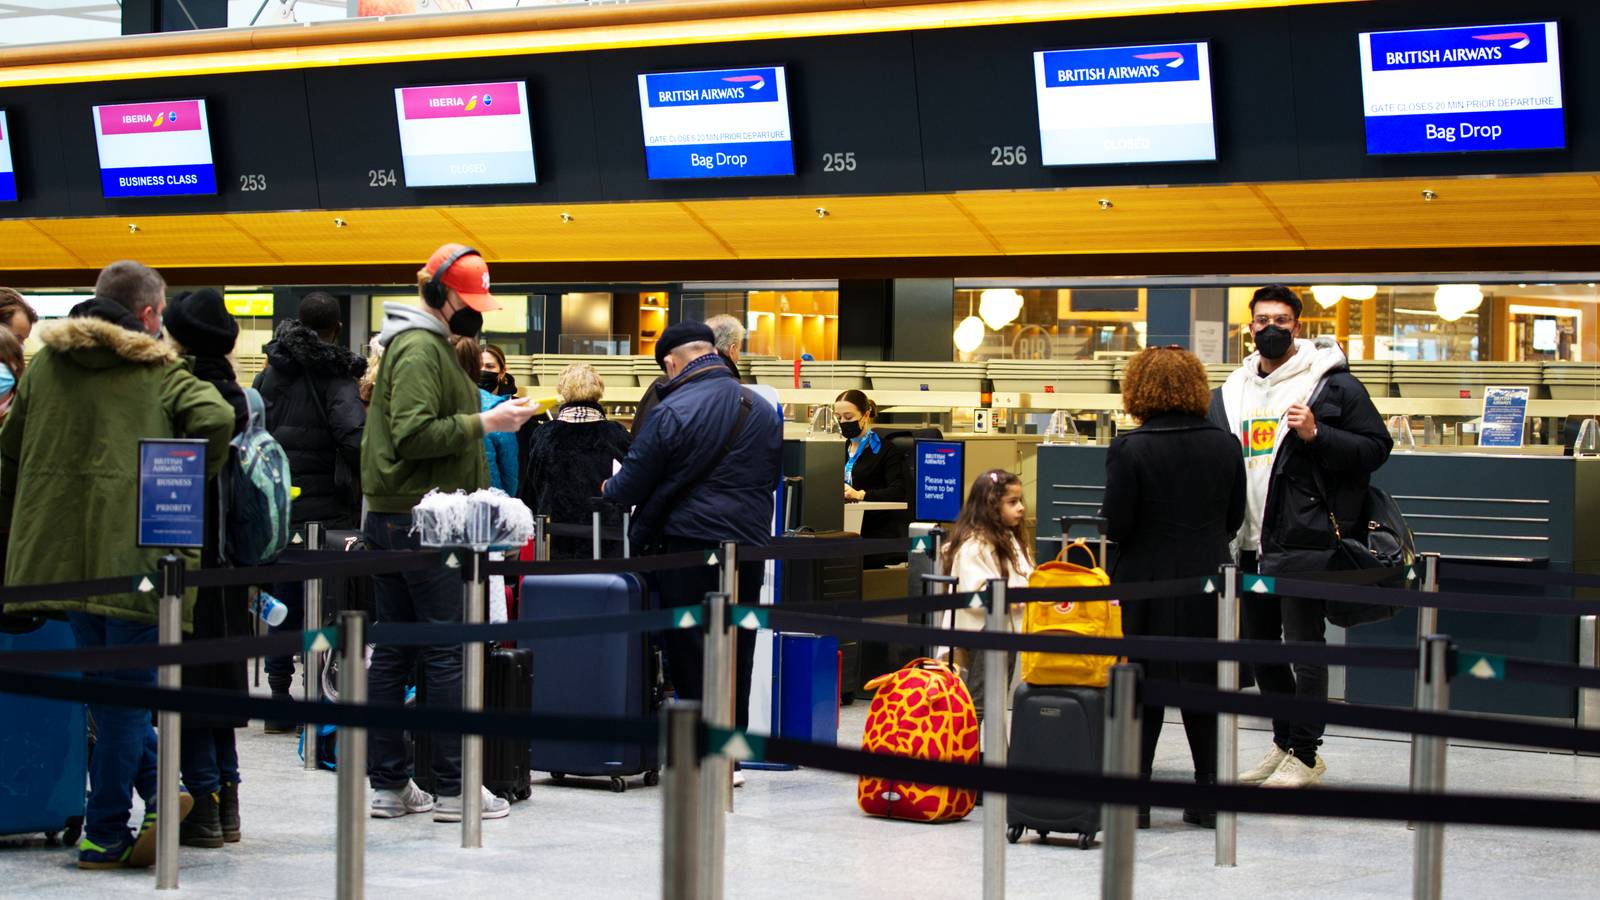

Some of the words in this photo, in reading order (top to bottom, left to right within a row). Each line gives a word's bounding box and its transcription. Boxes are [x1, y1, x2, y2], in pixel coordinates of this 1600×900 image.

[1386, 49, 1440, 65] BRITISH
[1442, 46, 1502, 62] AIRWAYS
[1057, 68, 1106, 82] BRITISH
[1107, 65, 1160, 80] AIRWAYS
[658, 89, 699, 103] BRITISH
[701, 87, 745, 101] AIRWAYS
[429, 97, 465, 108] IBERIA
[1370, 103, 1395, 113] GATE
[1397, 102, 1433, 112] CLOSES
[1435, 101, 1446, 111] 20
[1447, 100, 1465, 110] MIN
[1466, 99, 1495, 109] PRIOR
[1497, 96, 1555, 108] DEPARTURE
[122, 114, 153, 124] IBERIA
[720, 132, 743, 141] PRIOR
[743, 130, 785, 140] DEPARTURE
[1425, 123, 1456, 142] Bag
[1459, 122, 1502, 140] Drop
[691, 153, 714, 169] Bag
[716, 152, 748, 168] Drop
[822, 152, 857, 172] 255
[990, 146, 1027, 166] 256
[119, 175, 165, 187] BUSINESS
[166, 174, 198, 185] CLASS
[240, 174, 267, 191] 253
[368, 169, 397, 187] 254
[152, 465, 183, 473] AIRWAYS
[156, 479, 192, 487] BUSINESS
[924, 475, 943, 484] Please
[170, 491, 177, 499] &
[946, 484, 954, 493] be
[155, 504, 192, 512] PRIORITY
